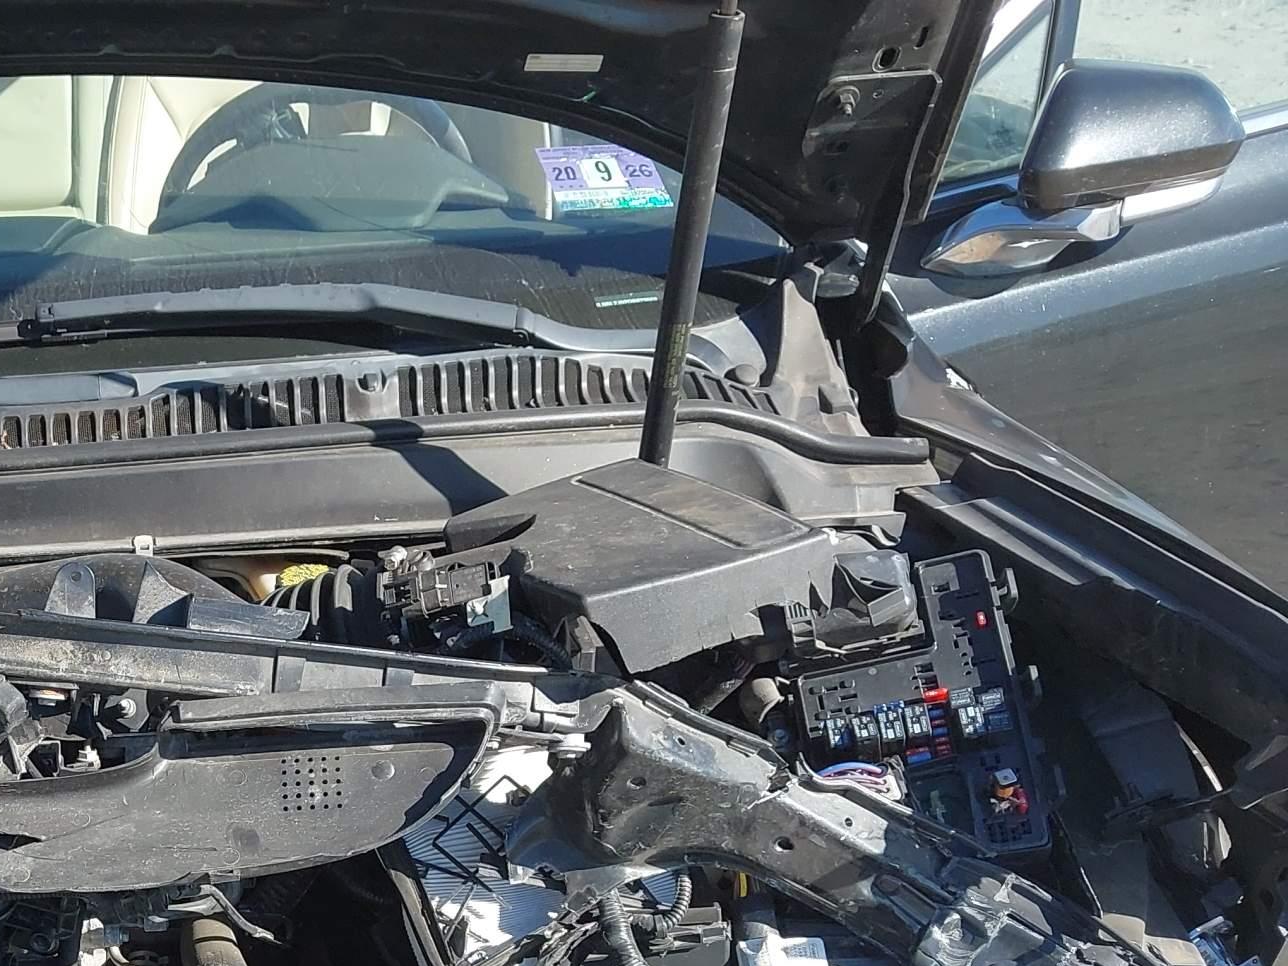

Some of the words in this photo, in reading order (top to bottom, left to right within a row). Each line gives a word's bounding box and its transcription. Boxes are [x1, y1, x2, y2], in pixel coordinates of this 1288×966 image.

[552, 165, 577, 181] 20
[594, 160, 612, 182] 9
[625, 163, 654, 178] 26
